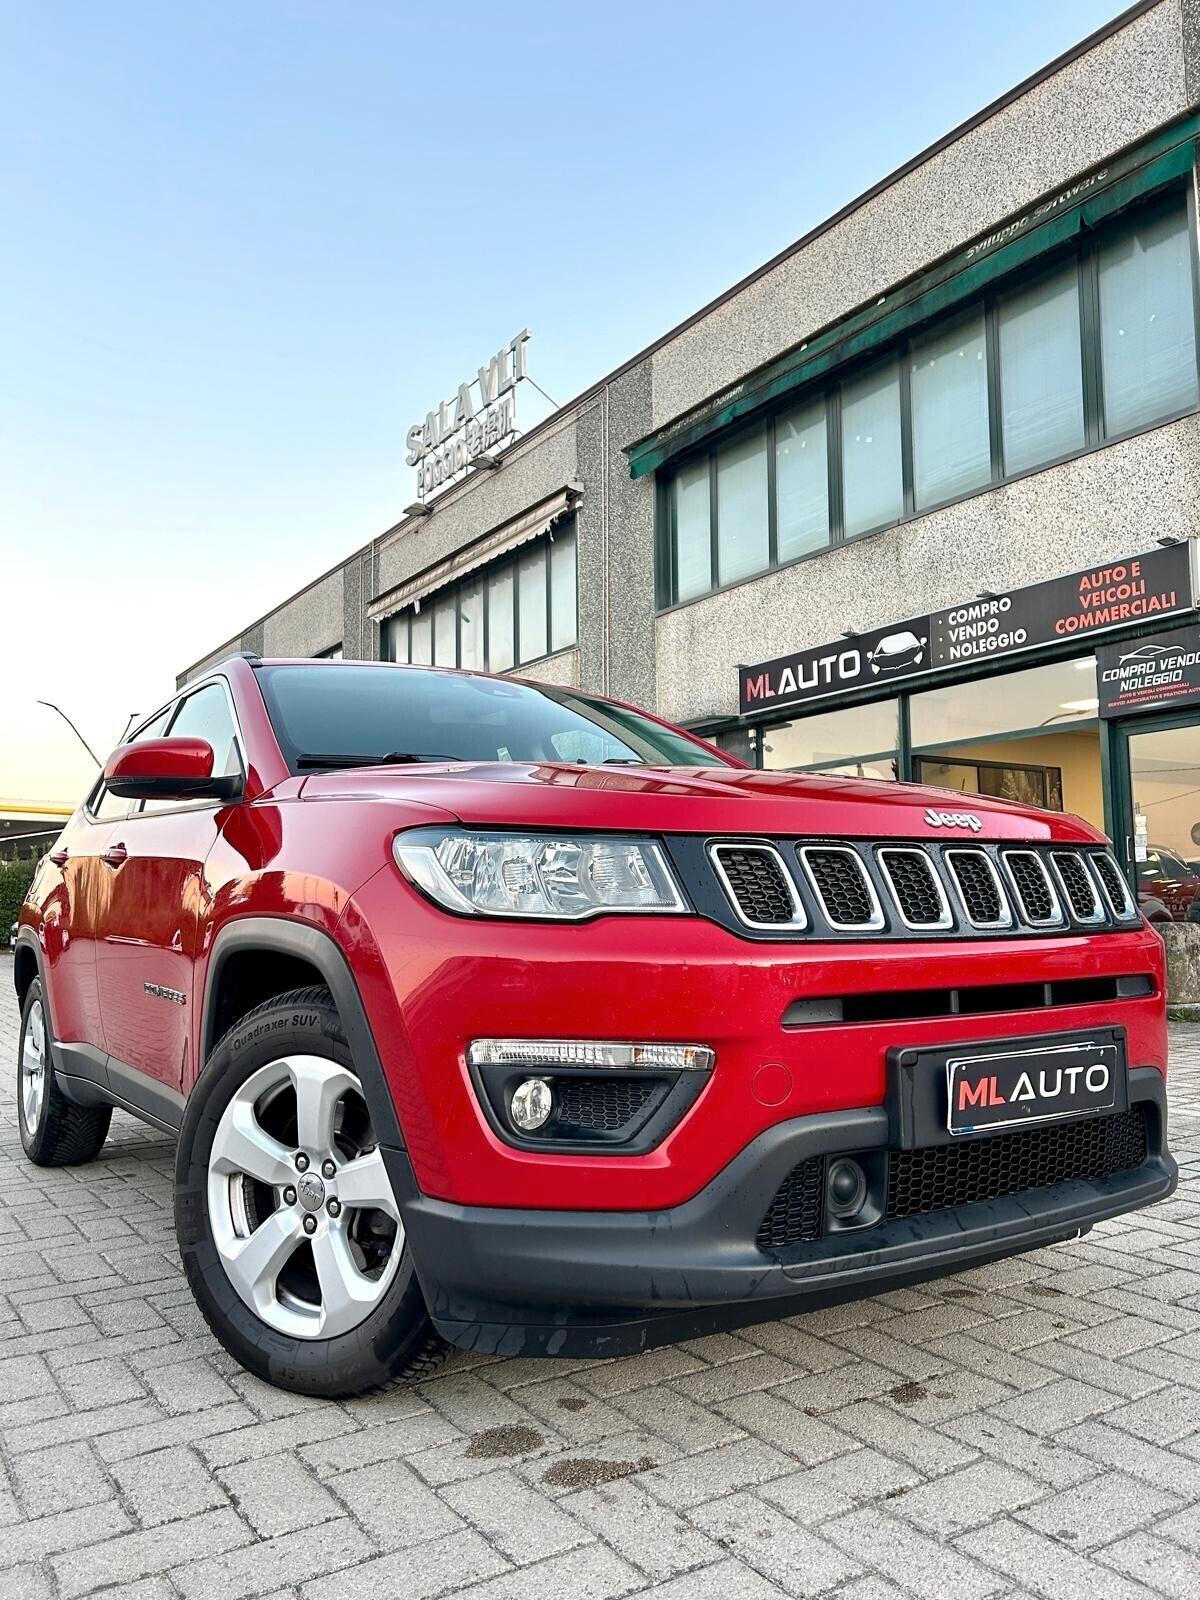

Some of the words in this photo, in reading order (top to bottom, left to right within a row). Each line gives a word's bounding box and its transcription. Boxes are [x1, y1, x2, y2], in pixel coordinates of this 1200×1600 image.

[405, 382, 474, 467] SALA
[478, 328, 532, 408] VLT
[1079, 566, 1128, 592] AUTO
[1131, 561, 1141, 577] E
[1079, 579, 1146, 609] VEICOLI
[948, 597, 1012, 626] COMPRO
[1055, 591, 1176, 635] COMMERCIALI
[949, 618, 1000, 643] VENDO
[949, 628, 1028, 660] NOLEGGIO
[777, 649, 861, 695] AUTO
[1102, 661, 1156, 682] COMPRO
[1120, 669, 1183, 692] NOLEGGIO
[1137, 688, 1156, 696] VEICOLI
[1156, 682, 1190, 692] COMMERCIALI
[923, 808, 983, 833] Jeep
[232, 1018, 289, 1051] Quadraxer
[291, 1014, 318, 1028] SUV
[957, 1075, 1006, 1111] ML
[1009, 1064, 1110, 1103] AUTO
